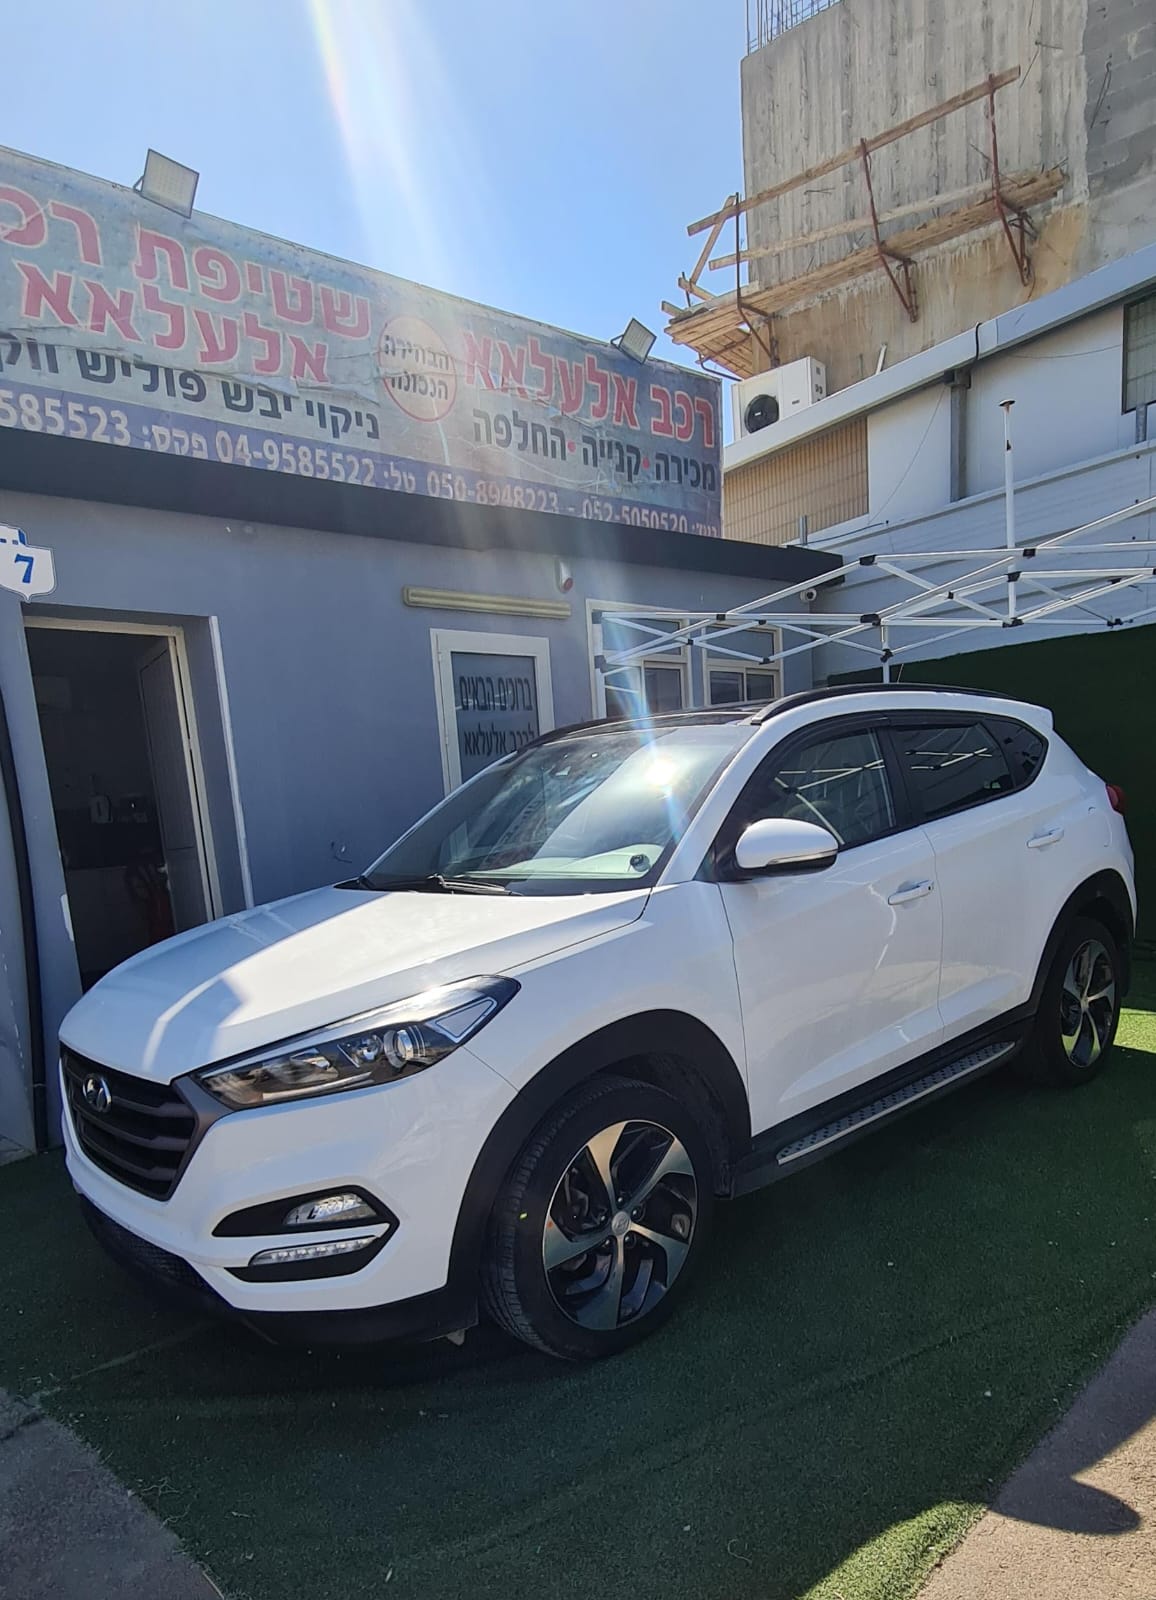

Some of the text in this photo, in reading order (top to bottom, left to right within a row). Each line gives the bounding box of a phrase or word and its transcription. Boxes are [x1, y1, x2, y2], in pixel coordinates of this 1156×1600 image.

[132, 226, 372, 339] שטיפת
[15, 260, 331, 384] אלעלאא
[221, 381, 292, 419] יבש
[305, 400, 379, 439] ניקוי
[650, 384, 714, 448] רכב
[215, 430, 376, 487] 04-9585522
[427, 470, 559, 513] 050-8948223
[14, 553, 34, 584] 7
[458, 676, 533, 711] ברוכים הבאים
